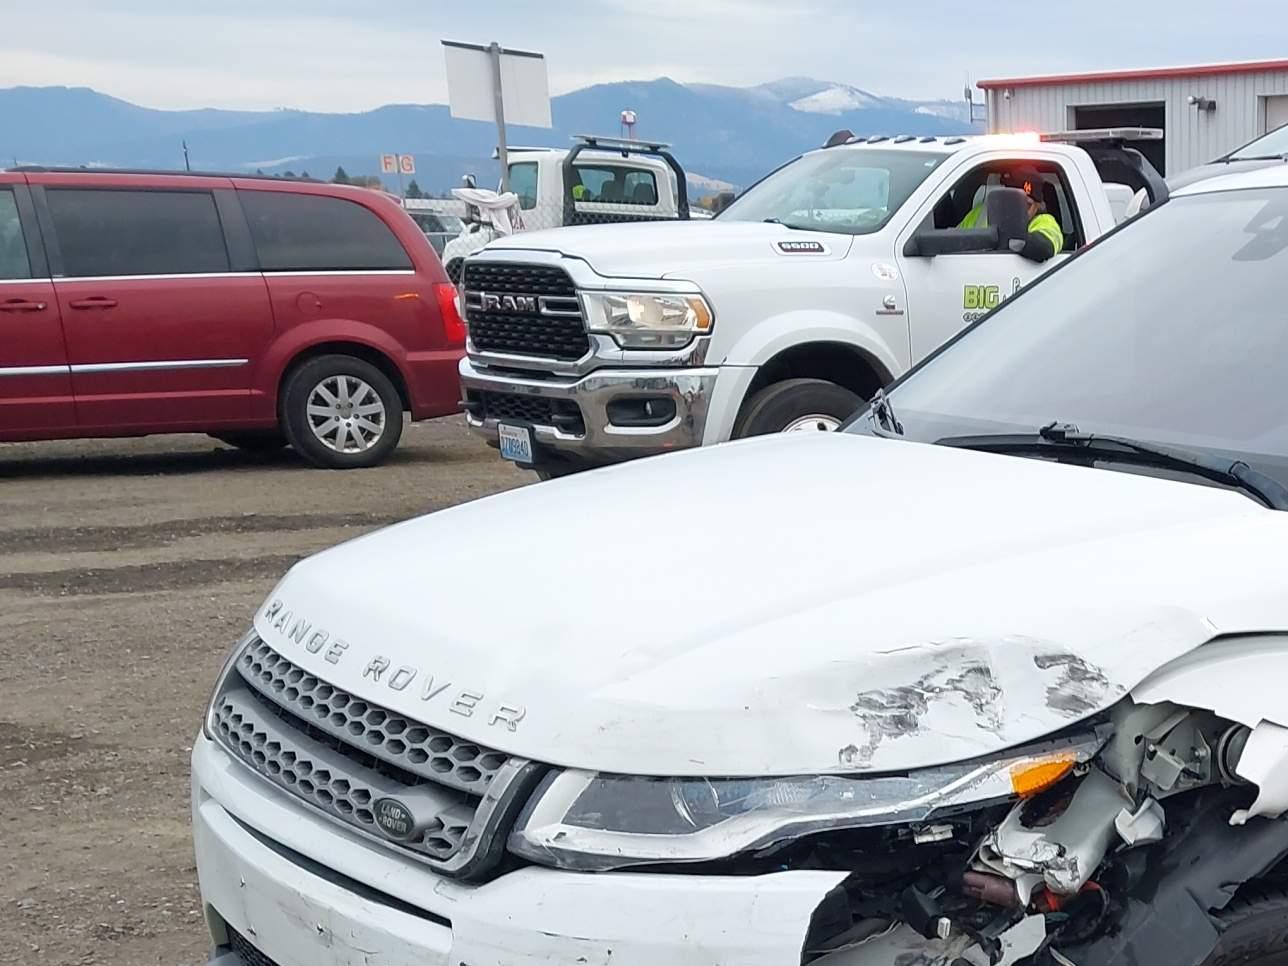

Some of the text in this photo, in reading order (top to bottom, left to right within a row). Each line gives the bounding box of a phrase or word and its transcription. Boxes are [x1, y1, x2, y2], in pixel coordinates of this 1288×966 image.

[382, 155, 394, 173] F
[400, 155, 414, 173] G
[480, 290, 536, 312] RAM
[963, 284, 1000, 310] BIG
[264, 599, 527, 732] RANGE ROVER
[381, 803, 401, 820] LAND
[382, 815, 407, 833] ROVER
